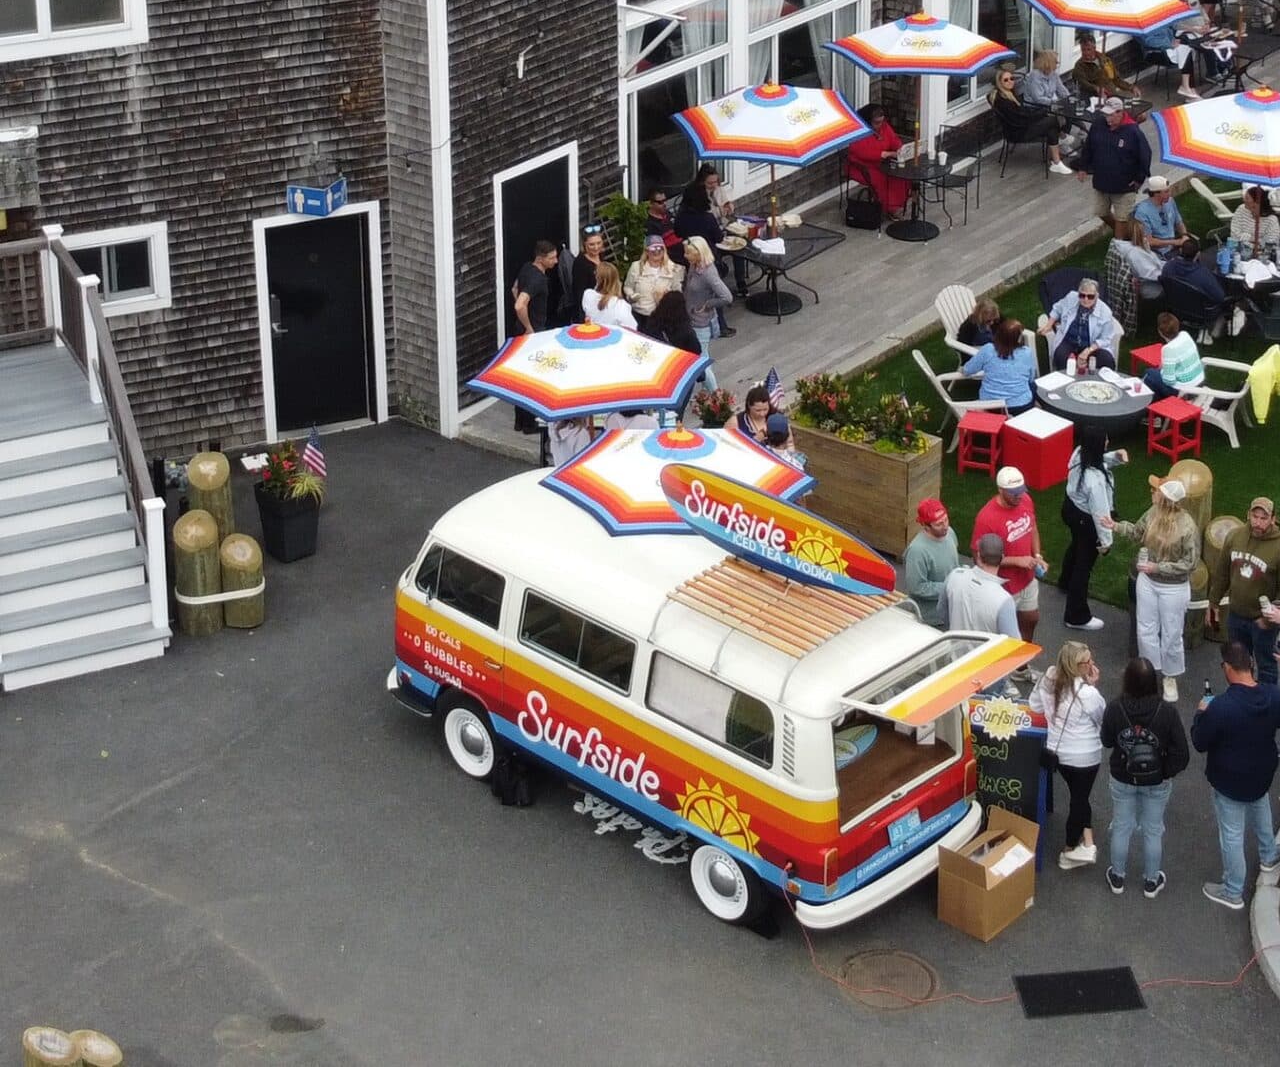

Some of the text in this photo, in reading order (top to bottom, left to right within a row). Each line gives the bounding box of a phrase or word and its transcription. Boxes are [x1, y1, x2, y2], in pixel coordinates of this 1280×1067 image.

[684, 479, 786, 551] Surfside
[732, 532, 757, 553] ICED
[759, 543, 783, 563] TEA
[794, 559, 835, 584] VODKA
[424, 641, 474, 677] BUBBLES
[439, 631, 462, 651] CALS
[972, 705, 1031, 728] Surfside
[518, 690, 661, 801] Surfside
